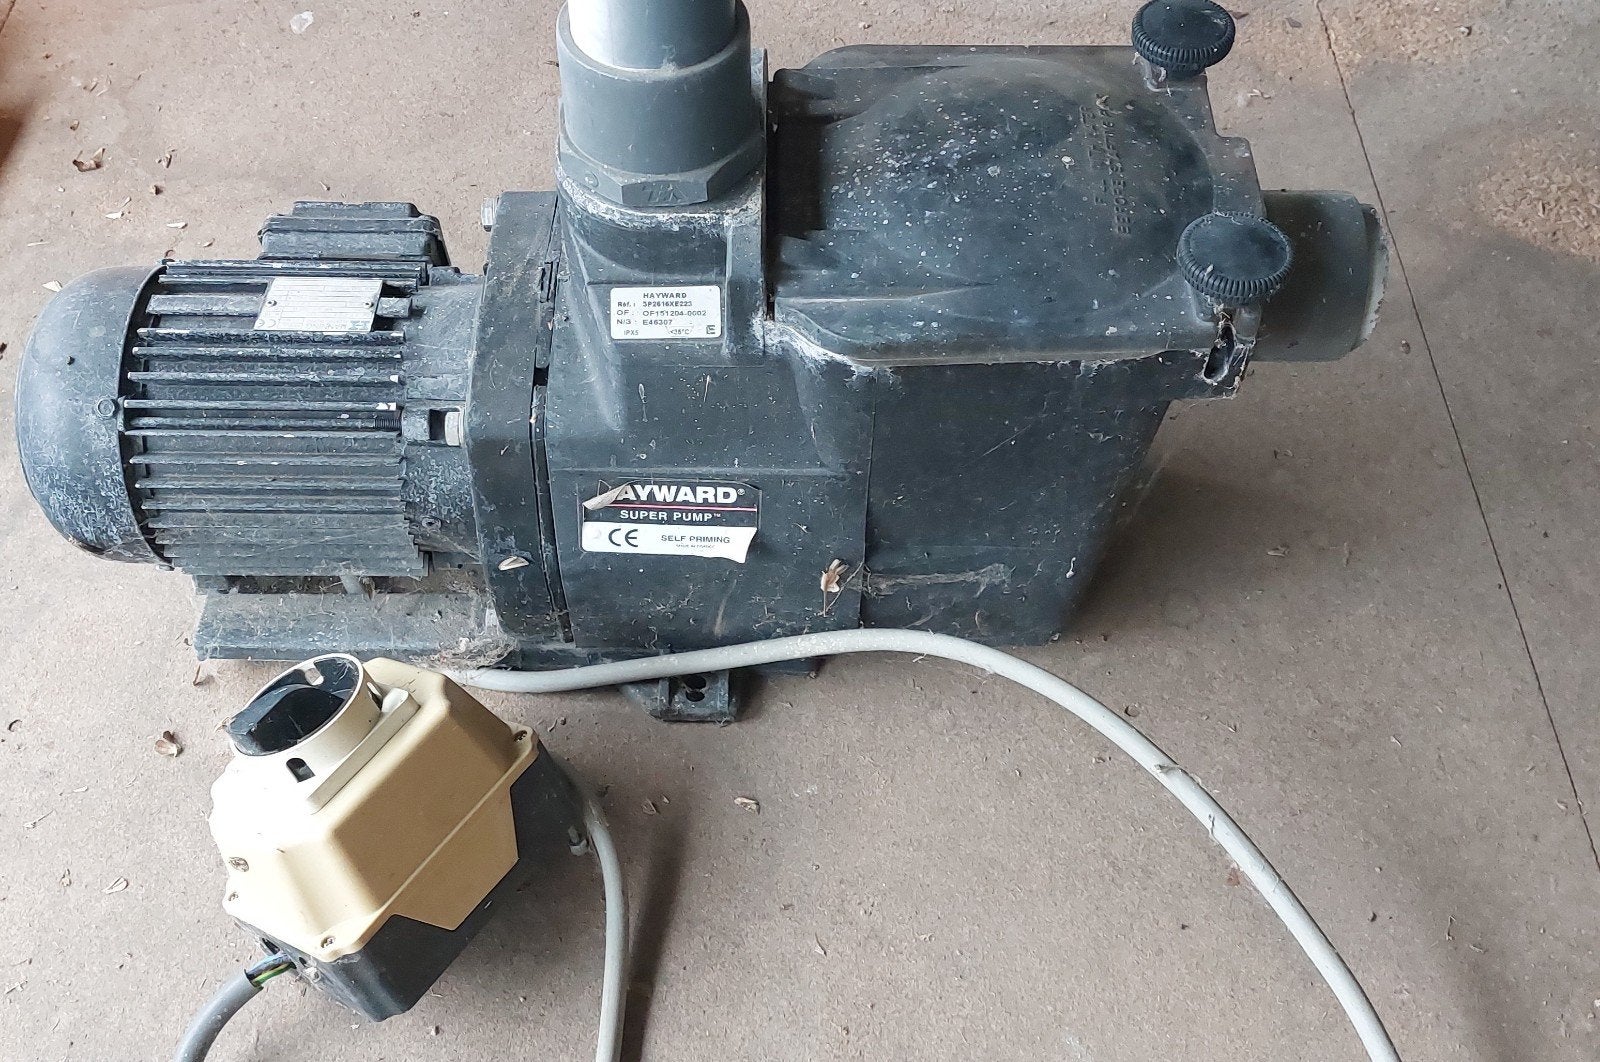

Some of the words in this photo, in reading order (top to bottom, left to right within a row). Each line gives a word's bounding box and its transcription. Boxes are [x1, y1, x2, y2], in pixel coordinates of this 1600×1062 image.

[619, 509, 668, 521] SUPER
[608, 527, 639, 548] CE
[661, 534, 687, 543] SELF
[689, 535, 731, 545] PRIMING
